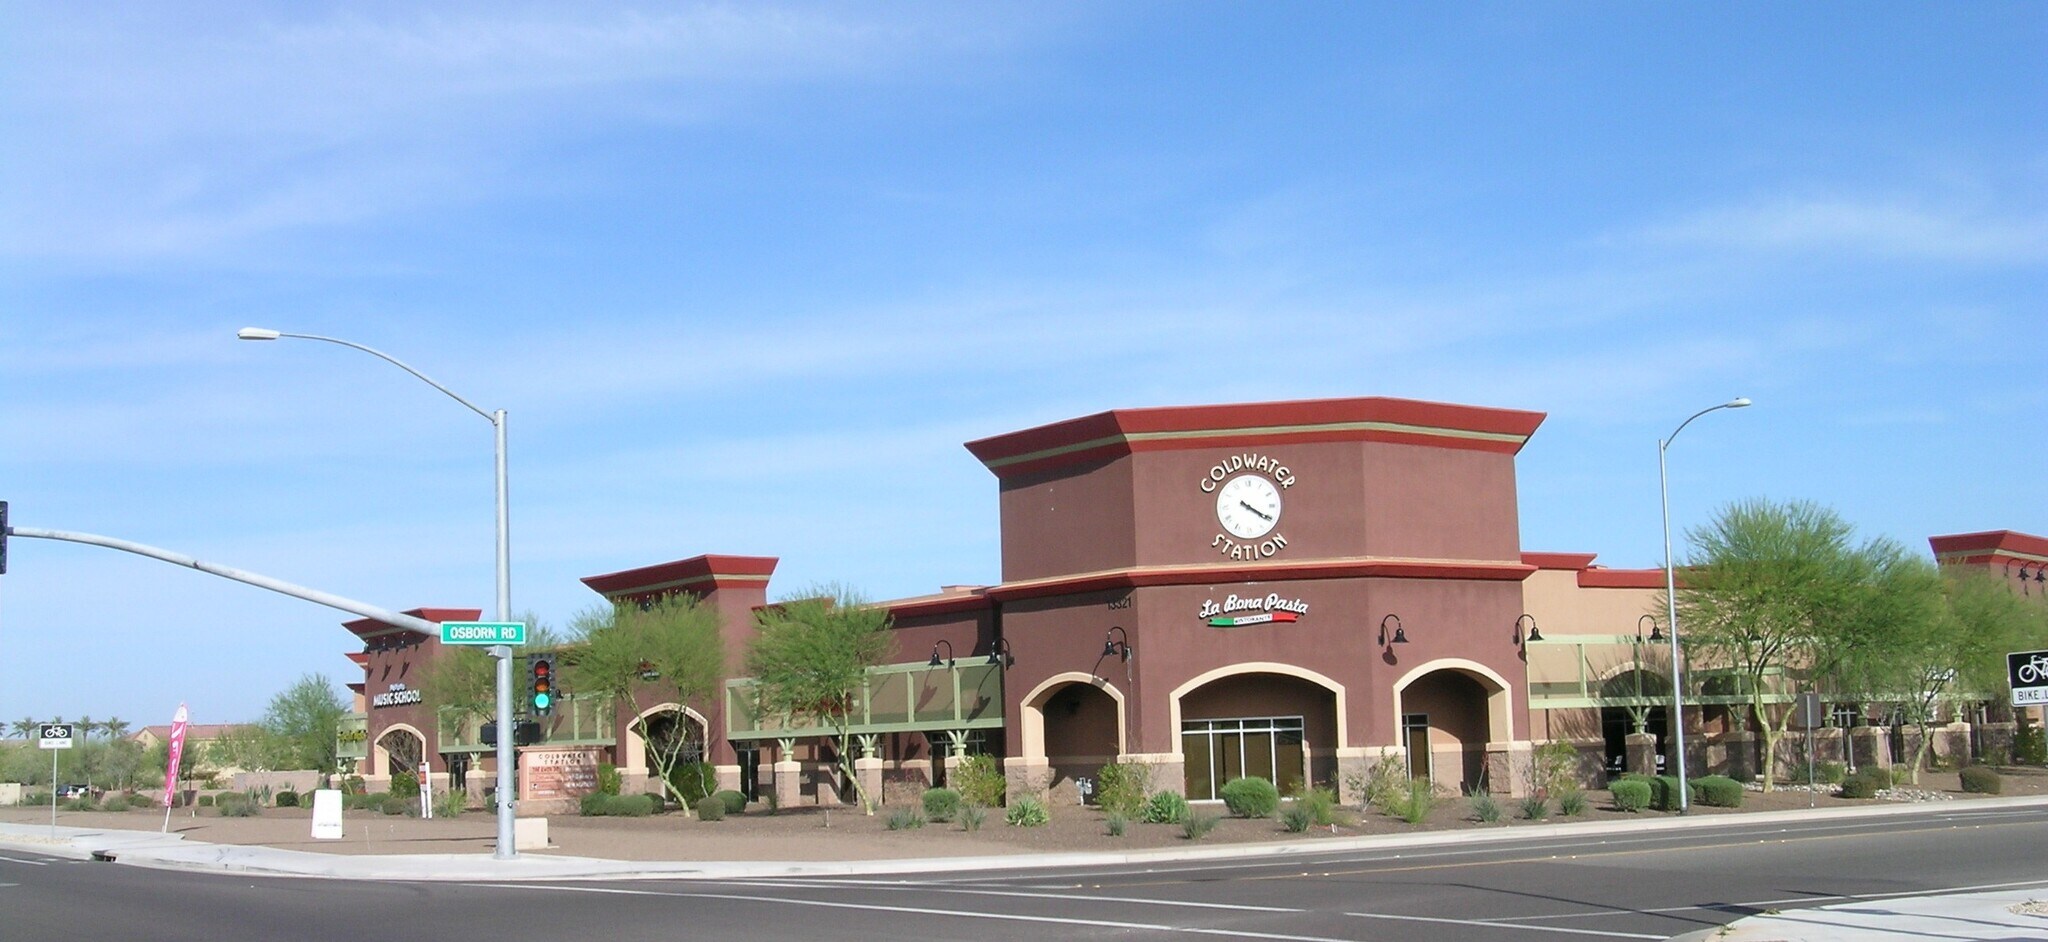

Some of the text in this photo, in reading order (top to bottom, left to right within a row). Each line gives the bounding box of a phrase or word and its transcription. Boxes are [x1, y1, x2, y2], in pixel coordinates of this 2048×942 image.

[1200, 453, 1296, 493] COLDWATER
[1212, 533, 1288, 560] STATION
[1199, 593, 1308, 618] La Bona Pasta
[450, 627, 516, 639] OSBORN RD
[373, 689, 421, 706] MUSIC SCHOOL
[2018, 690, 2040, 701] BIKE
